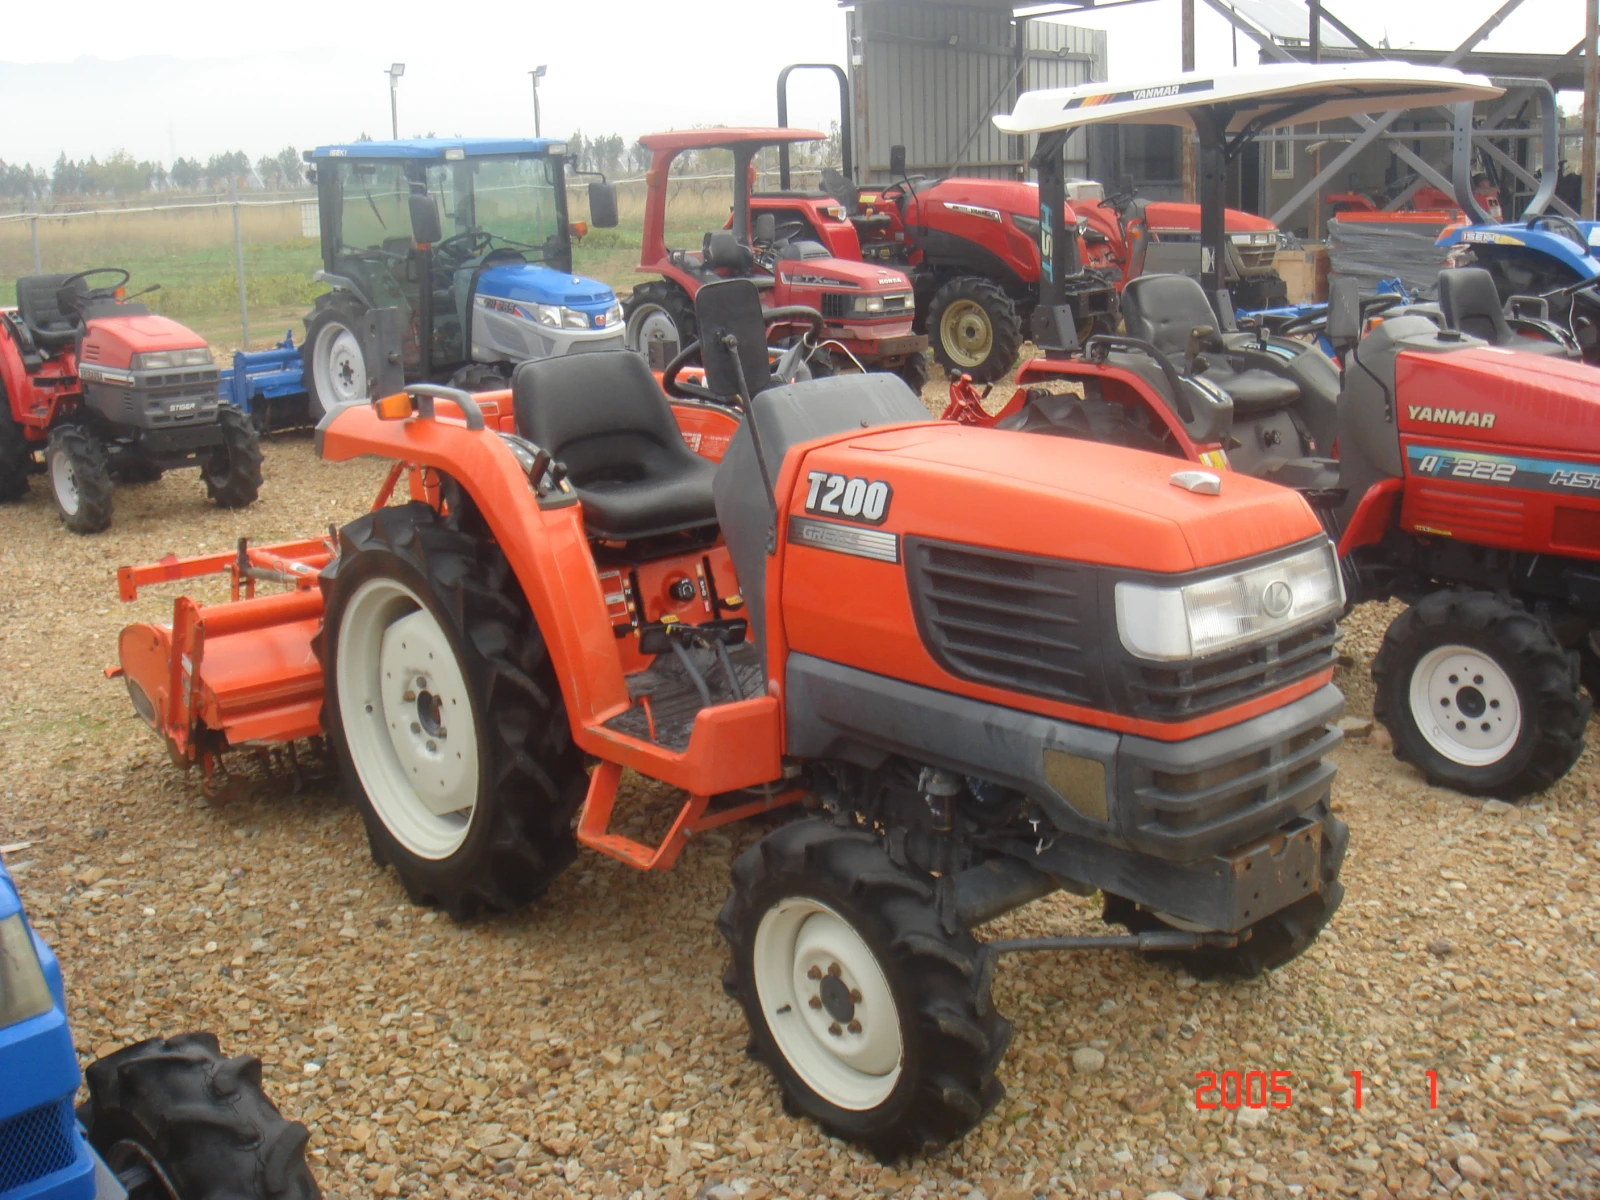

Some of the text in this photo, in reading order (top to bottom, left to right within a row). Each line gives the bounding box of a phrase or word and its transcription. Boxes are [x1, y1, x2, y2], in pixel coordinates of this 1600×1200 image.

[1132, 85, 1180, 101] YANMAR
[1041, 203, 1053, 283] HST
[878, 277, 902, 285] HONDA
[169, 403, 196, 412] STIGER
[1408, 405, 1496, 429] YANMAR
[805, 471, 889, 521] T200
